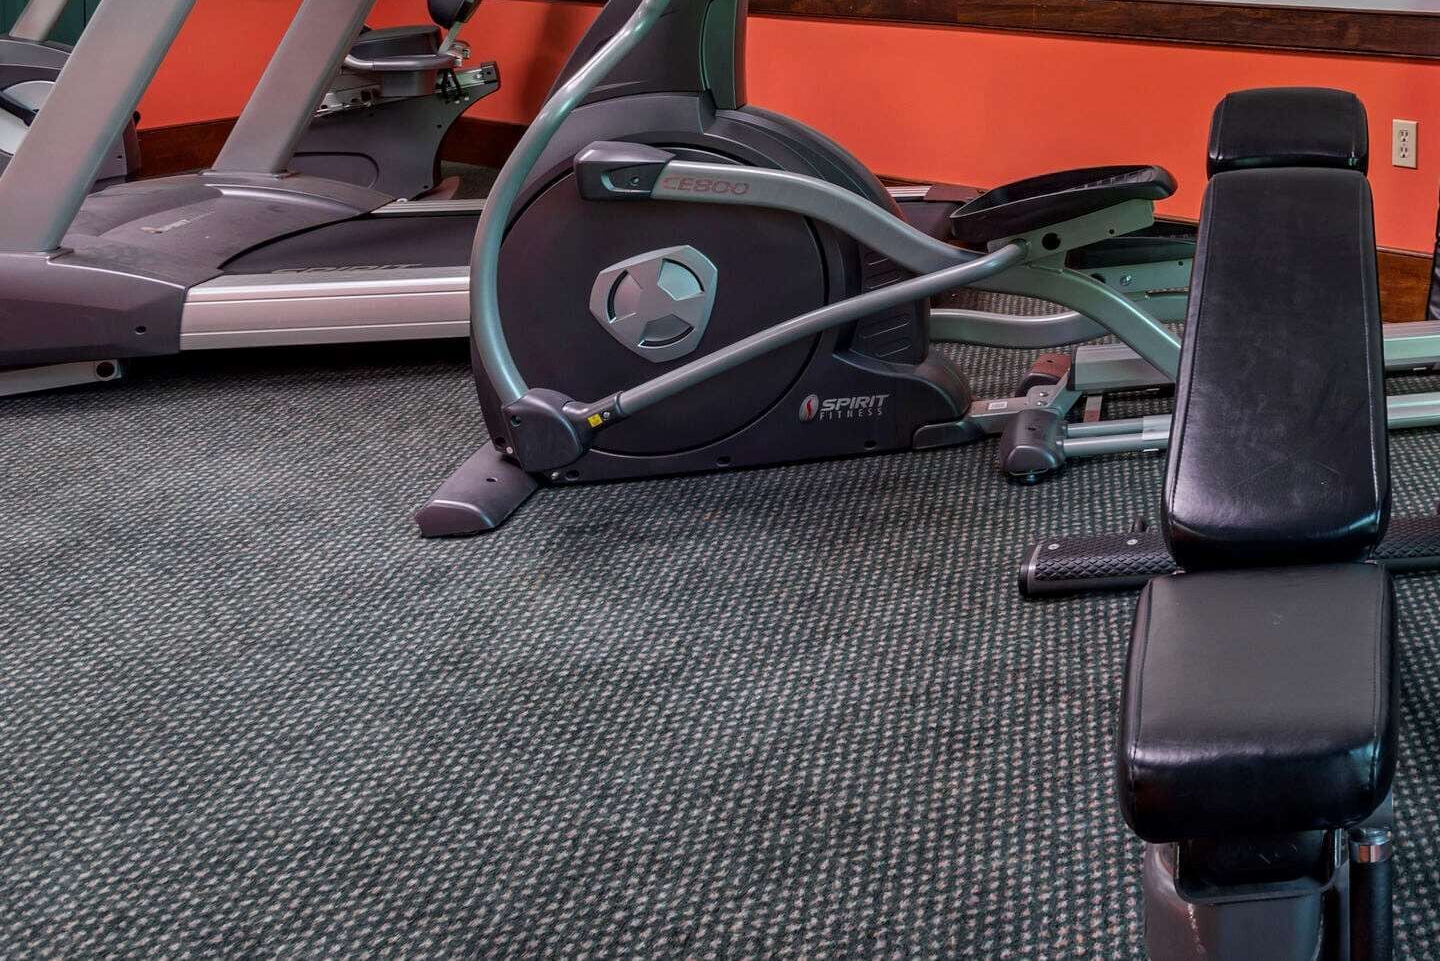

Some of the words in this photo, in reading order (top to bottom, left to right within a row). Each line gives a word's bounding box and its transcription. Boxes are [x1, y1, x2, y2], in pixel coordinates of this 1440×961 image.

[662, 175, 752, 195] CE800
[821, 394, 890, 411] SPIRIT
[820, 407, 883, 421] FITNESS
